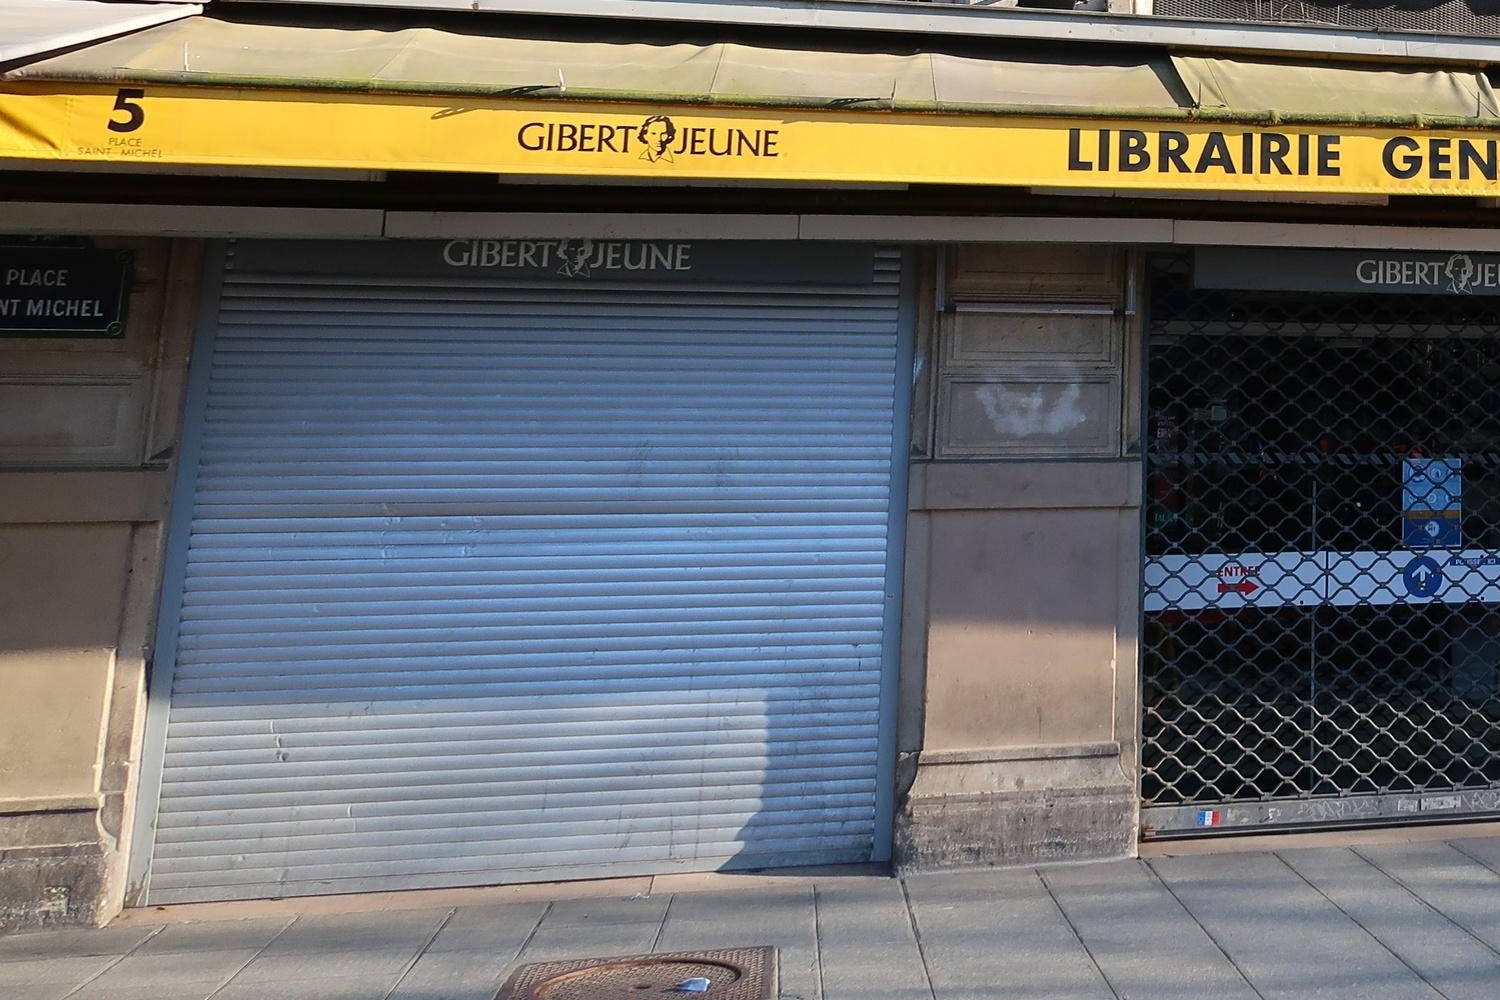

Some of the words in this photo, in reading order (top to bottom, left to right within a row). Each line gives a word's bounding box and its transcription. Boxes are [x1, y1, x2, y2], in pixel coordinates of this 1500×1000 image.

[107, 87, 145, 133] 5
[77, 146, 112, 155] SAINT
[120, 148, 163, 159] MICHEL
[108, 137, 142, 147] PLACE
[517, 122, 638, 153] GIBERT
[673, 127, 780, 157] JEUNE
[1068, 128, 1341, 177] LIBRAIRIE
[443, 239, 560, 268] GIBERT
[589, 242, 692, 271] JEUNE
[5, 268, 69, 287] PLACE
[1356, 259, 1445, 286] GIBERT
[25, 298, 104, 317] MICHEL
